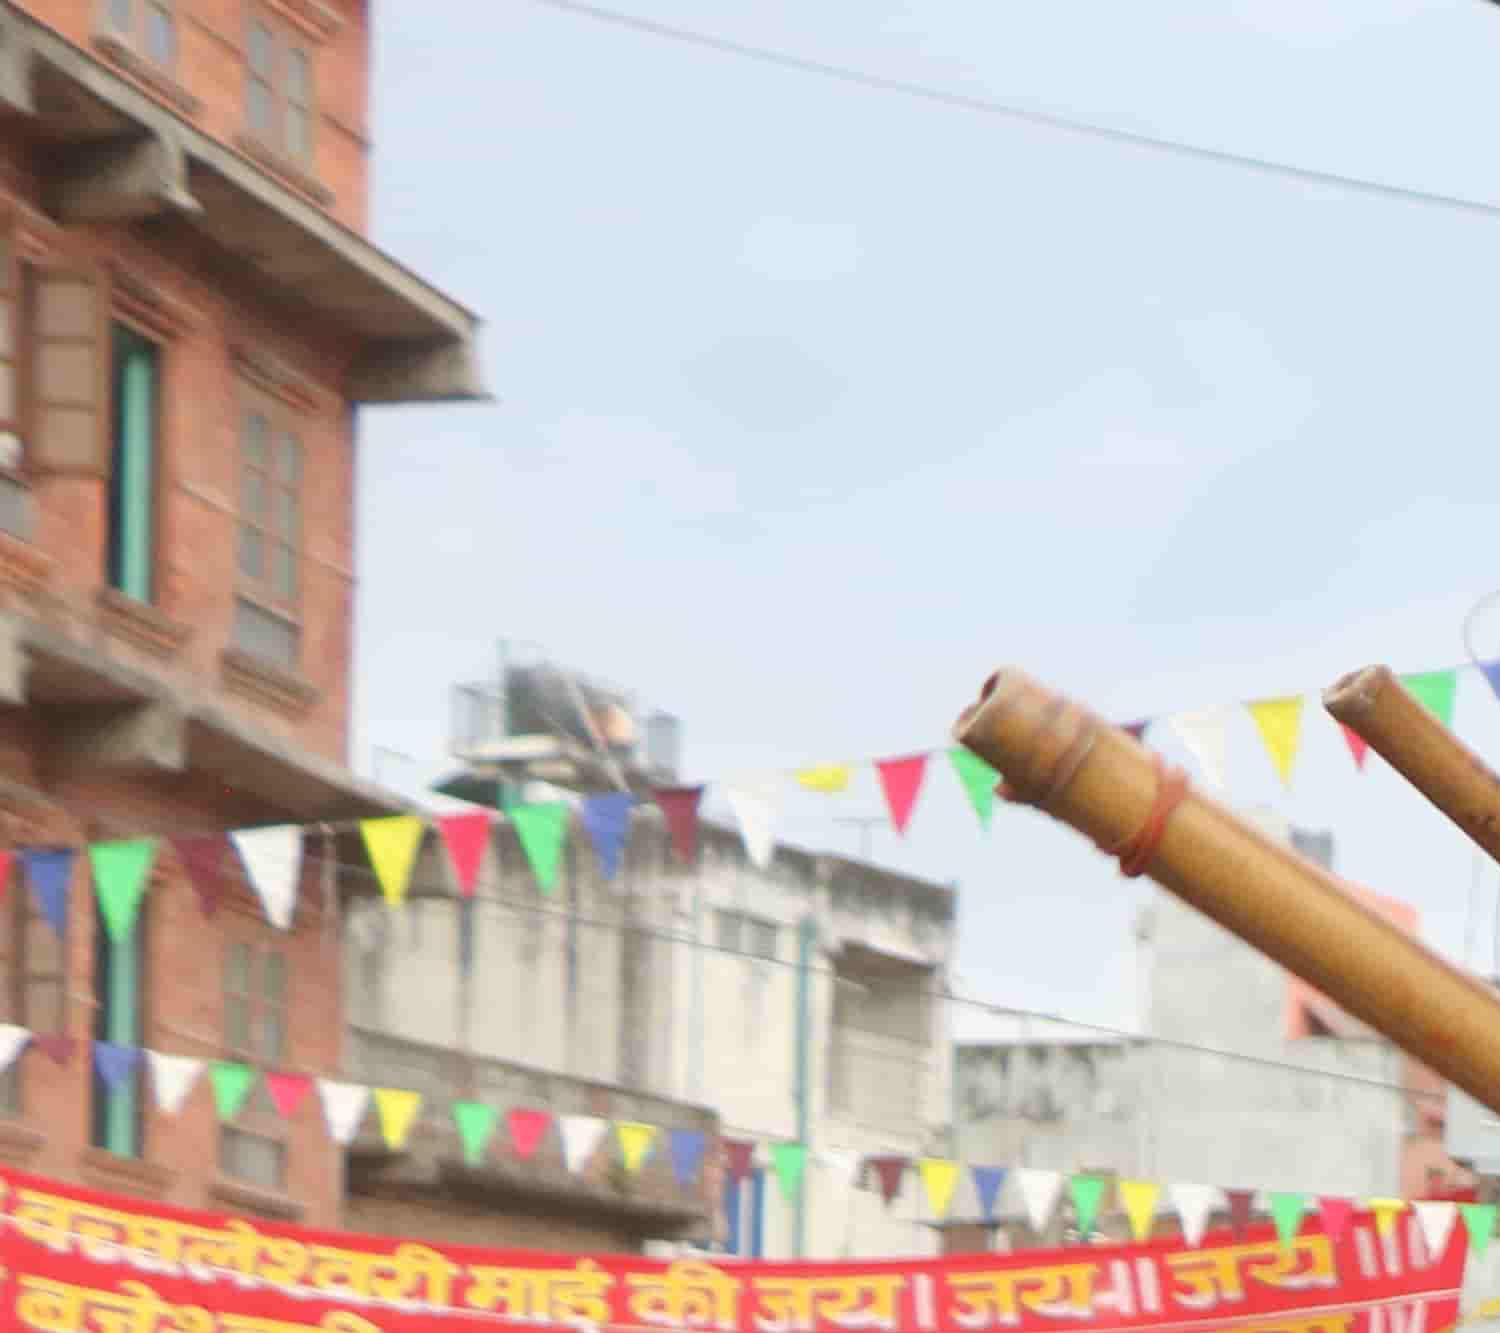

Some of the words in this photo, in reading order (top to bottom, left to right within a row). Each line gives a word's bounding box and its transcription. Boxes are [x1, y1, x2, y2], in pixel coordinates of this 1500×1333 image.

[625, 1259, 742, 1331] की
[751, 1273, 906, 1333] जय
[943, 1262, 1100, 1327] जय
[1164, 1233, 1338, 1310] जय
